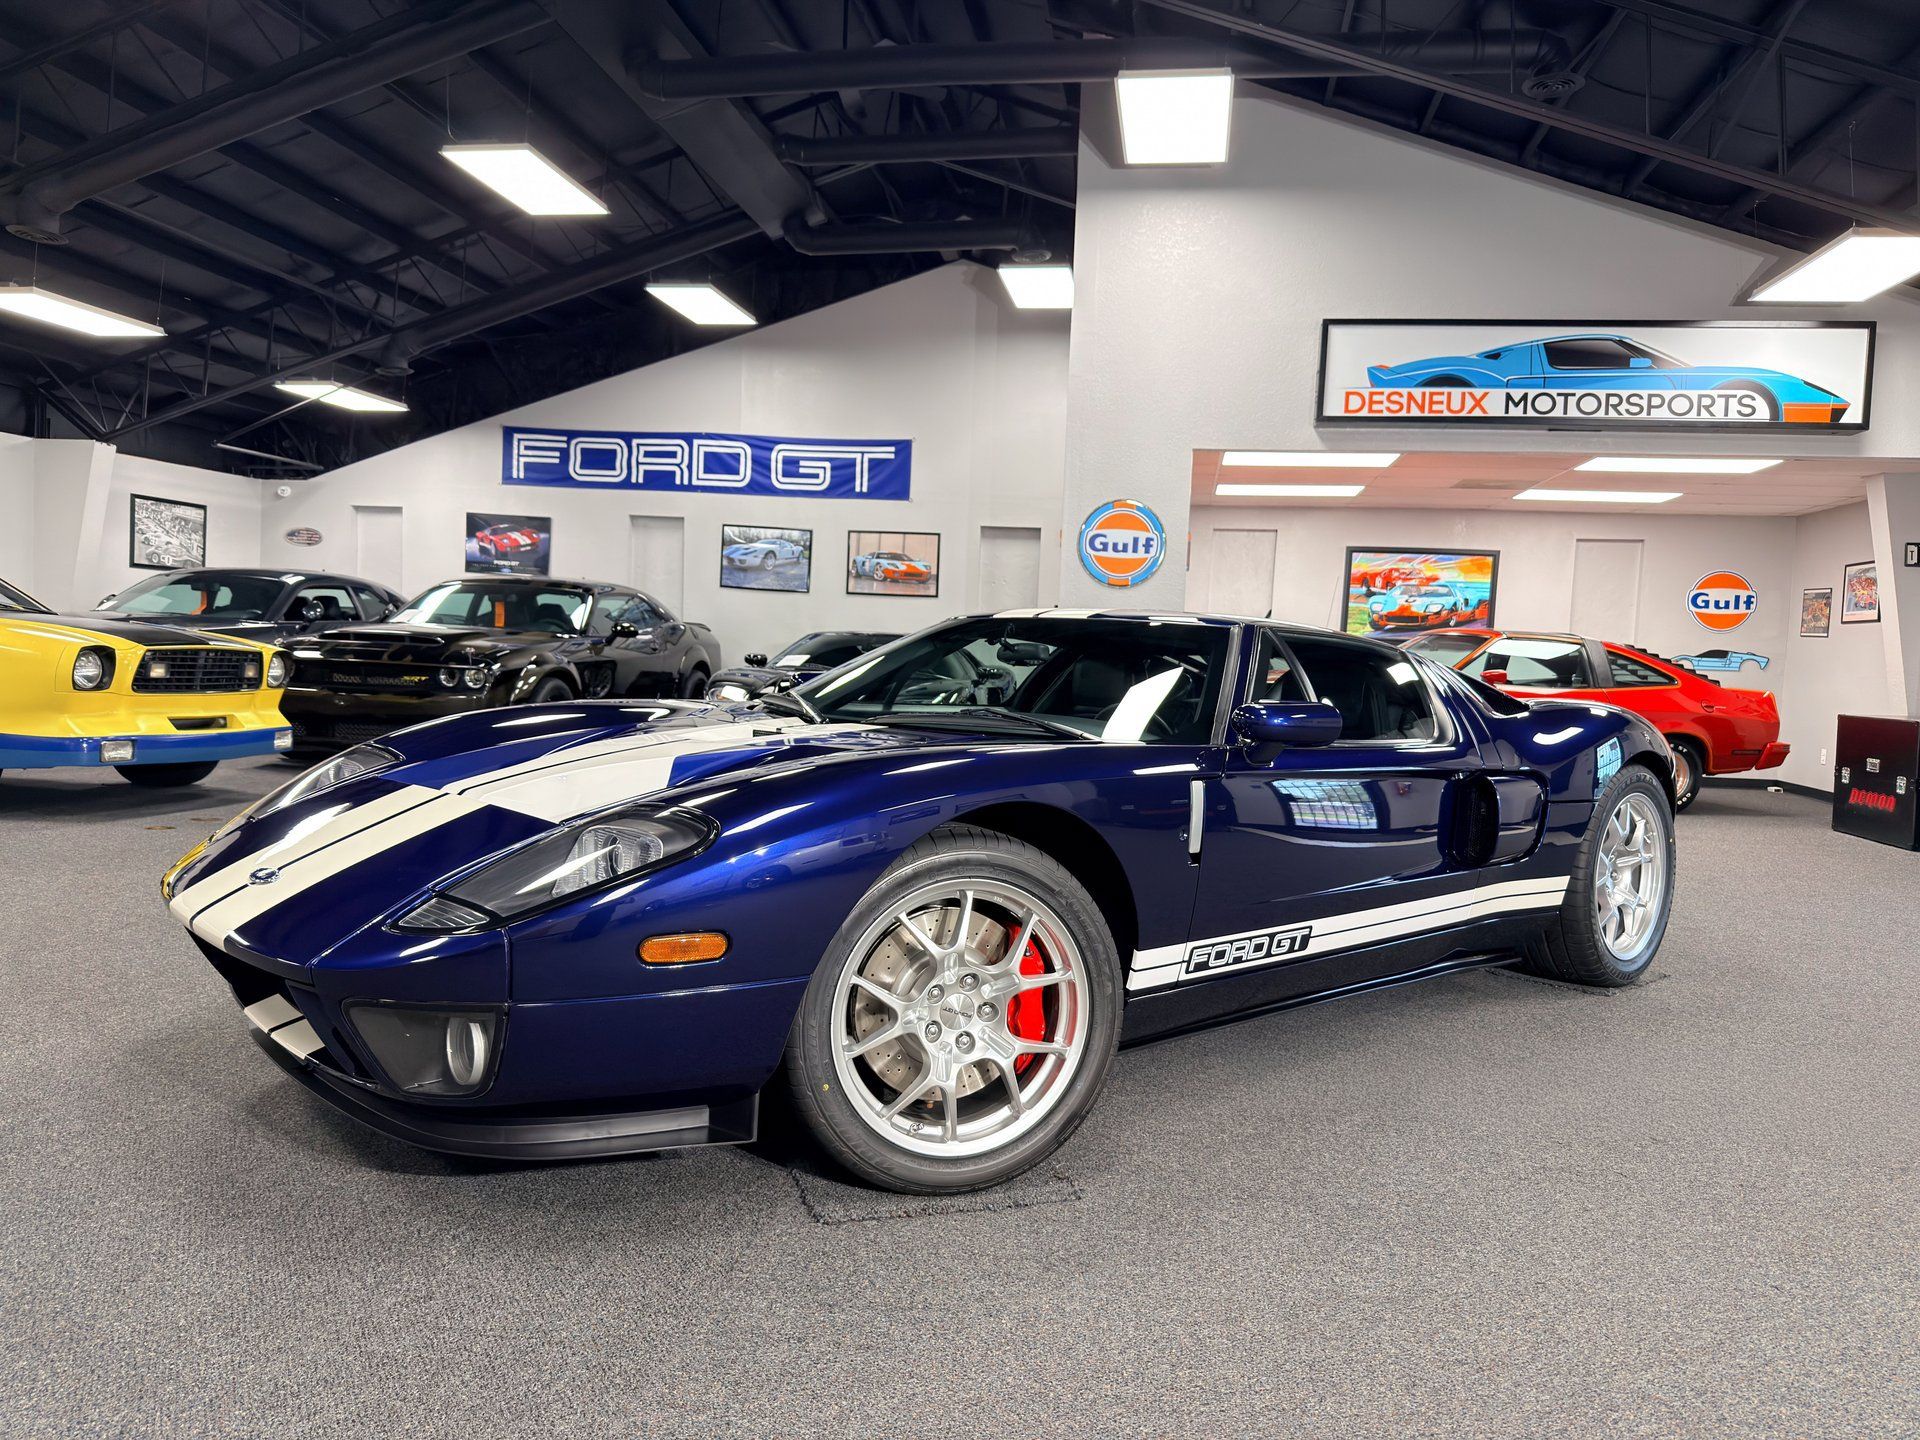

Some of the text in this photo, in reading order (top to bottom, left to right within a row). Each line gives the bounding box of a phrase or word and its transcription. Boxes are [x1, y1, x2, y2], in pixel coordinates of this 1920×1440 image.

[1343, 390, 1757, 417] DESNEUX MOTORSPORTS
[512, 433, 896, 493] FORD GT
[1088, 533, 1154, 554] Gulf
[1690, 592, 1755, 610] Gulf
[1188, 928, 1310, 972] FORD GT
